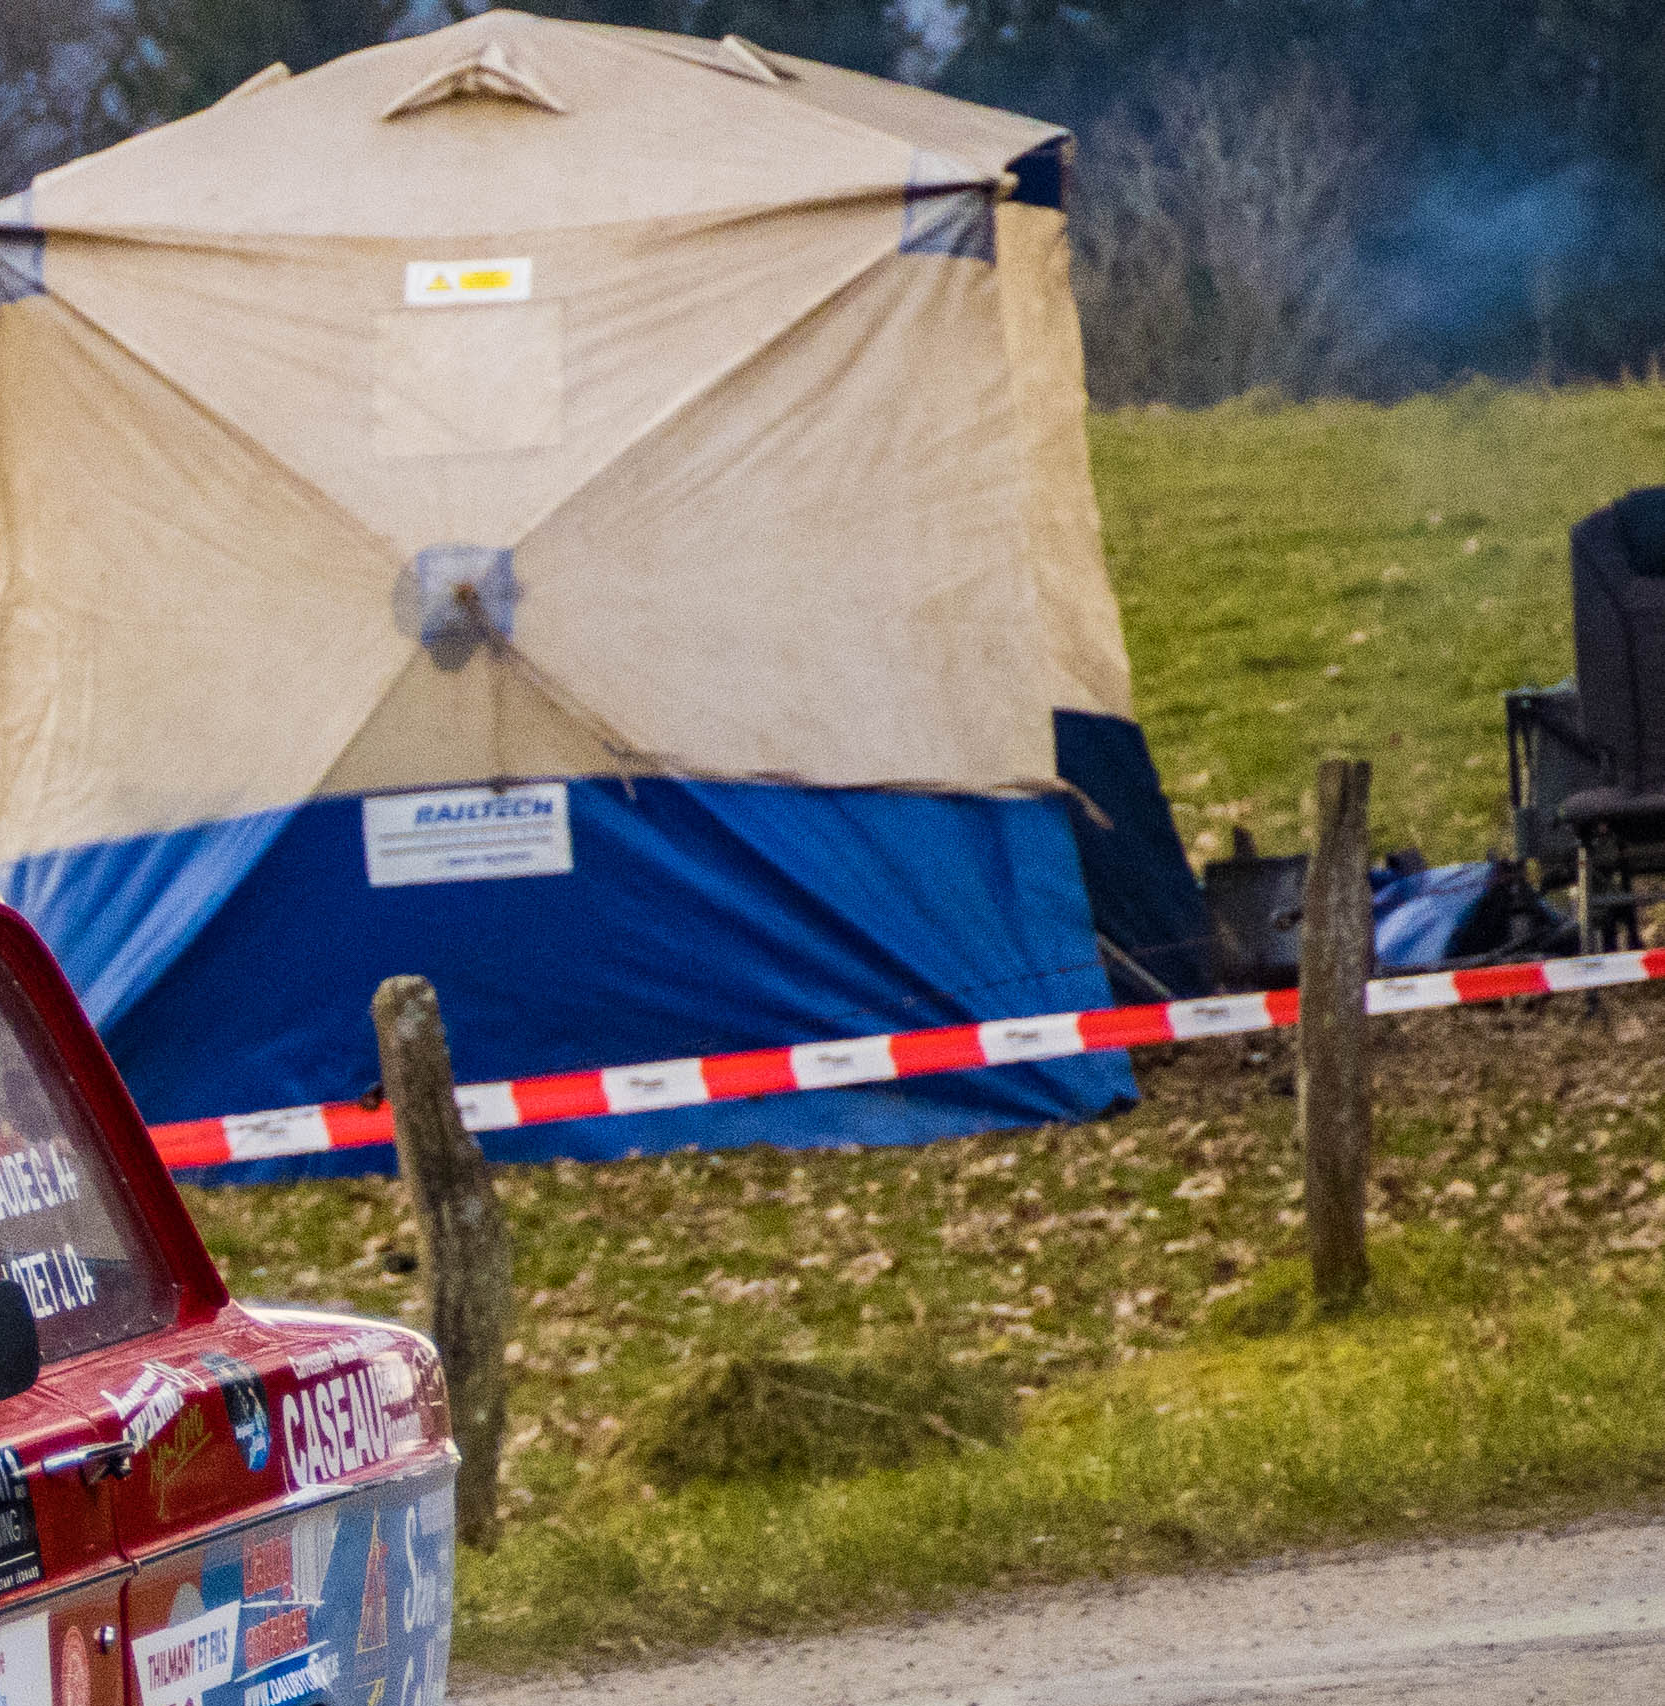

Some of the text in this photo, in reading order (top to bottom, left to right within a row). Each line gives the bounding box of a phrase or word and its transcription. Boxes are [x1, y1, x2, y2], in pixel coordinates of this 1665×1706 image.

[282, 1364, 387, 1488] CASEAU
[147, 1639, 196, 1692] THILMANT
[197, 1633, 208, 1673] ET
[210, 1625, 228, 1666] FILS
